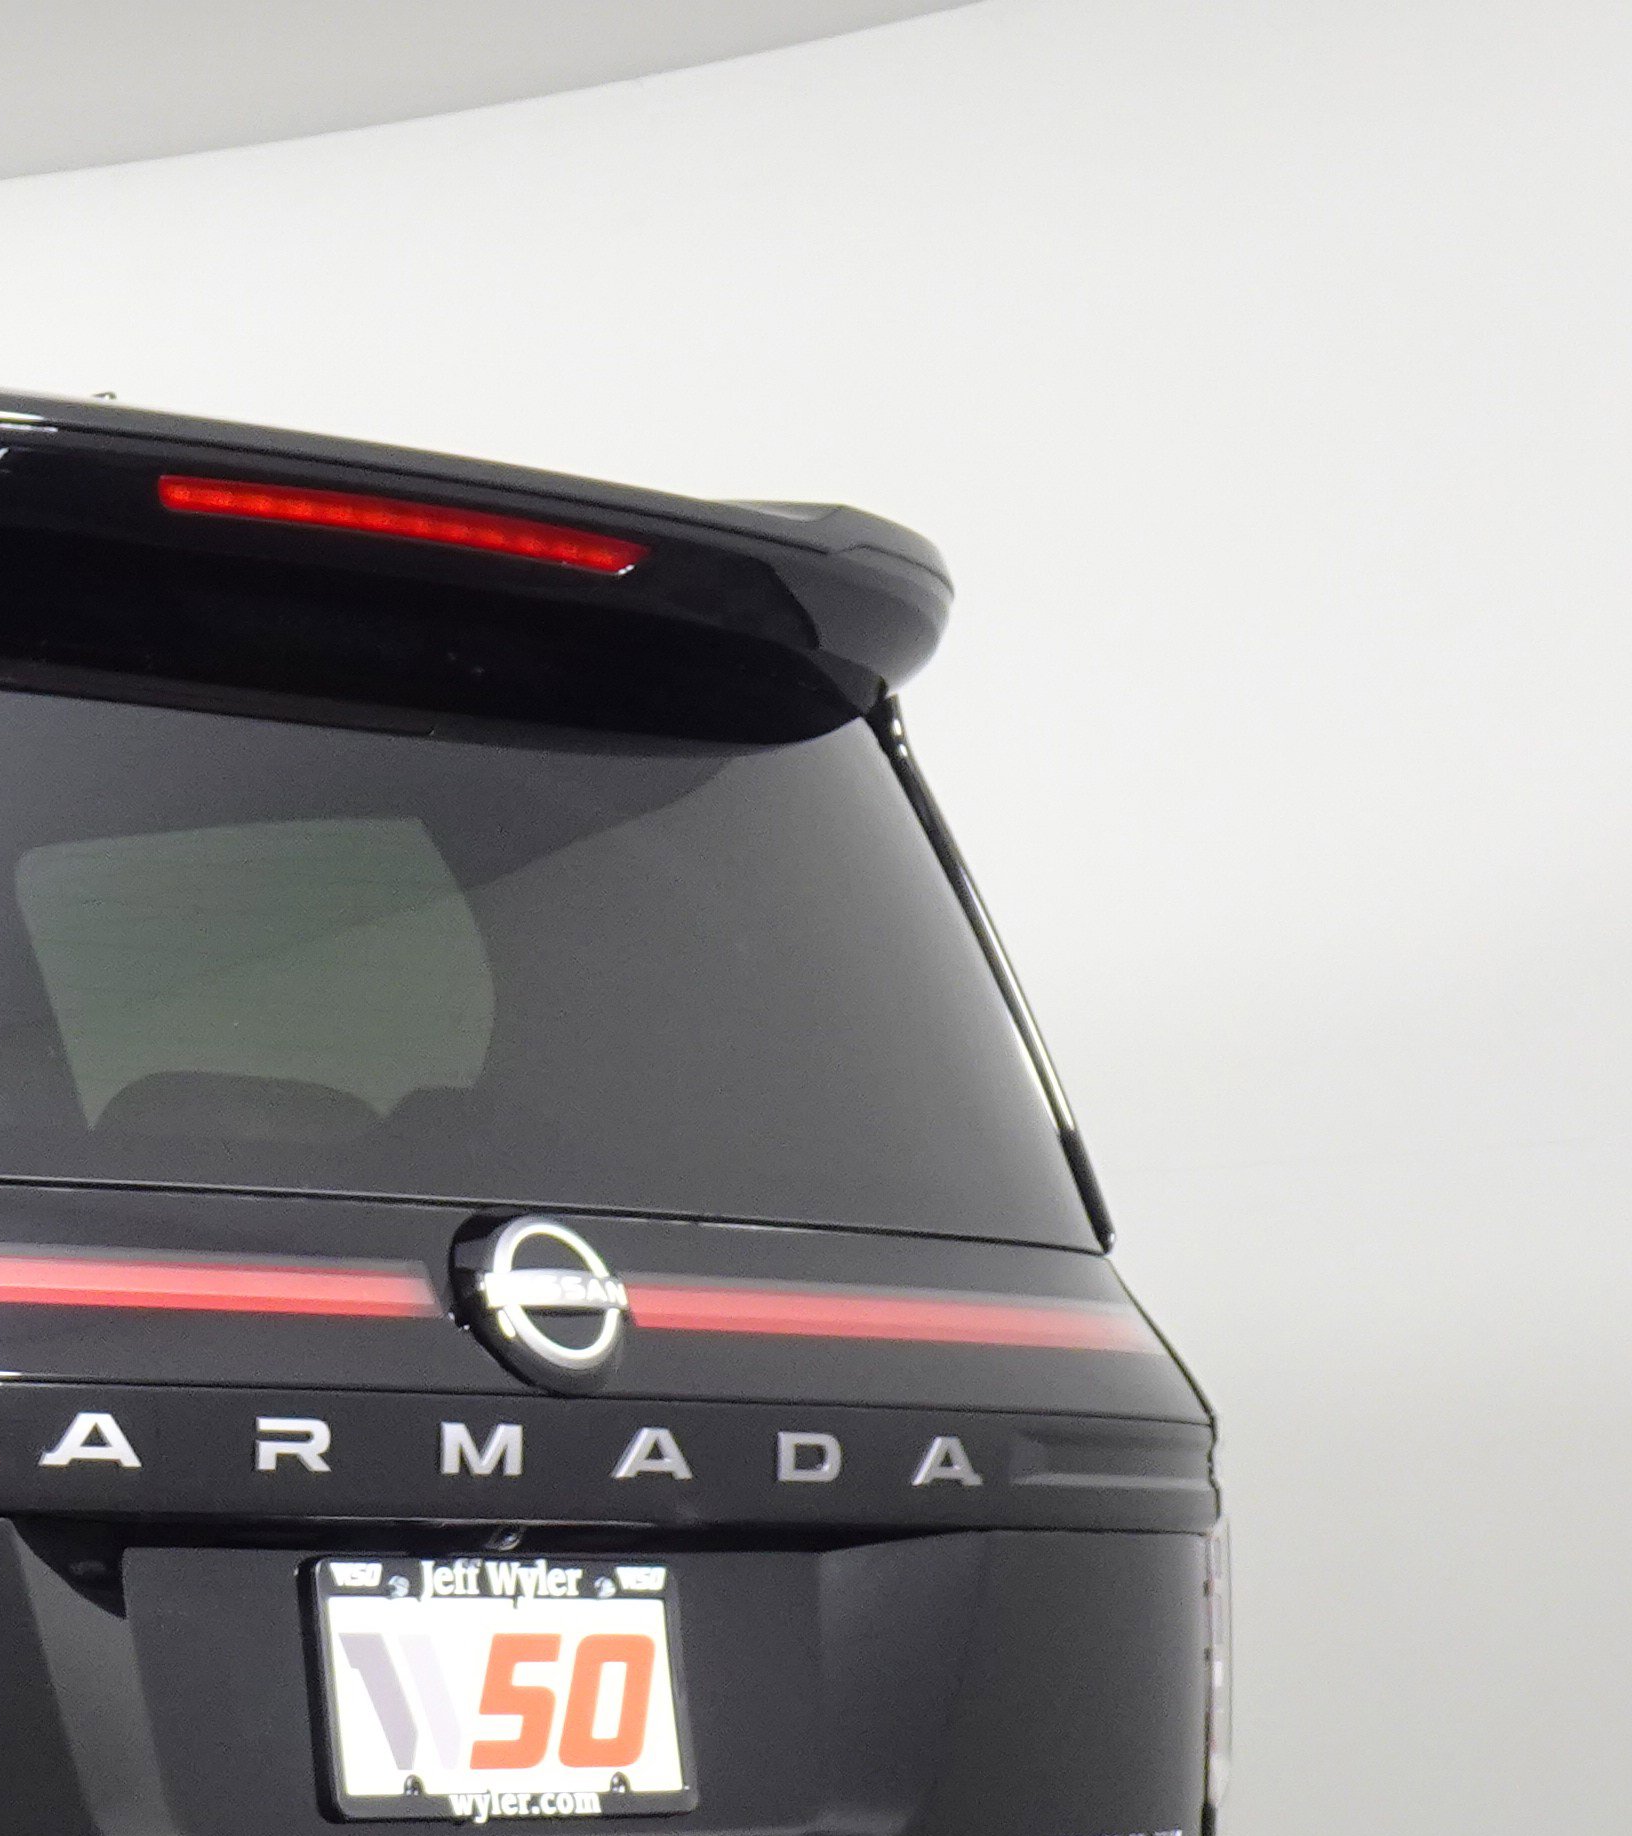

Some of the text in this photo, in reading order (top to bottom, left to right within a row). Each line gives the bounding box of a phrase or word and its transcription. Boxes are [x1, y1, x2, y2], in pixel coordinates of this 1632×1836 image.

[38, 1411, 984, 1487] ARMADA
[420, 1558, 582, 1602] Jeff Wyler
[448, 1790, 602, 1824] wyler.com
